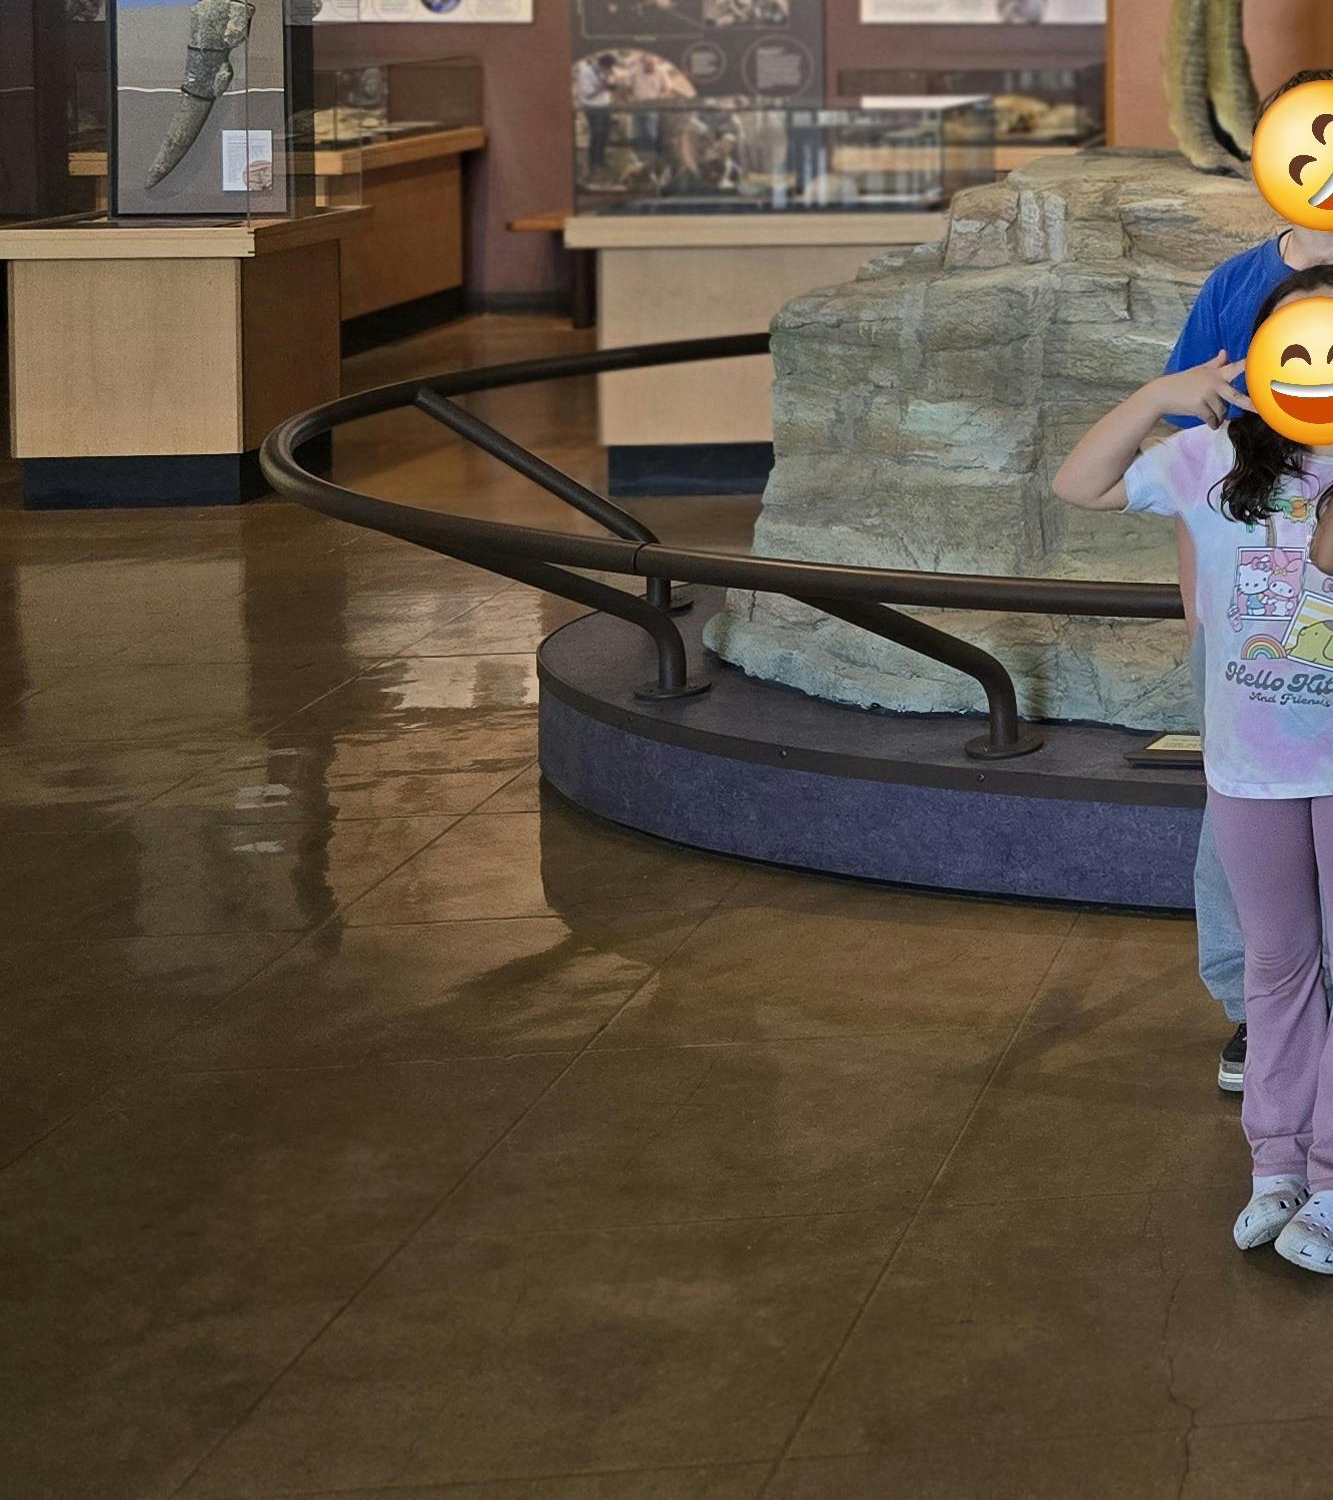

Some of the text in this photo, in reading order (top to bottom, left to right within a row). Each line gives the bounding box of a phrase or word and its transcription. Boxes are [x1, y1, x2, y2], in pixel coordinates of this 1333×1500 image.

[1225, 660, 1285, 692] Hello
[1249, 691, 1331, 707] And Friends
